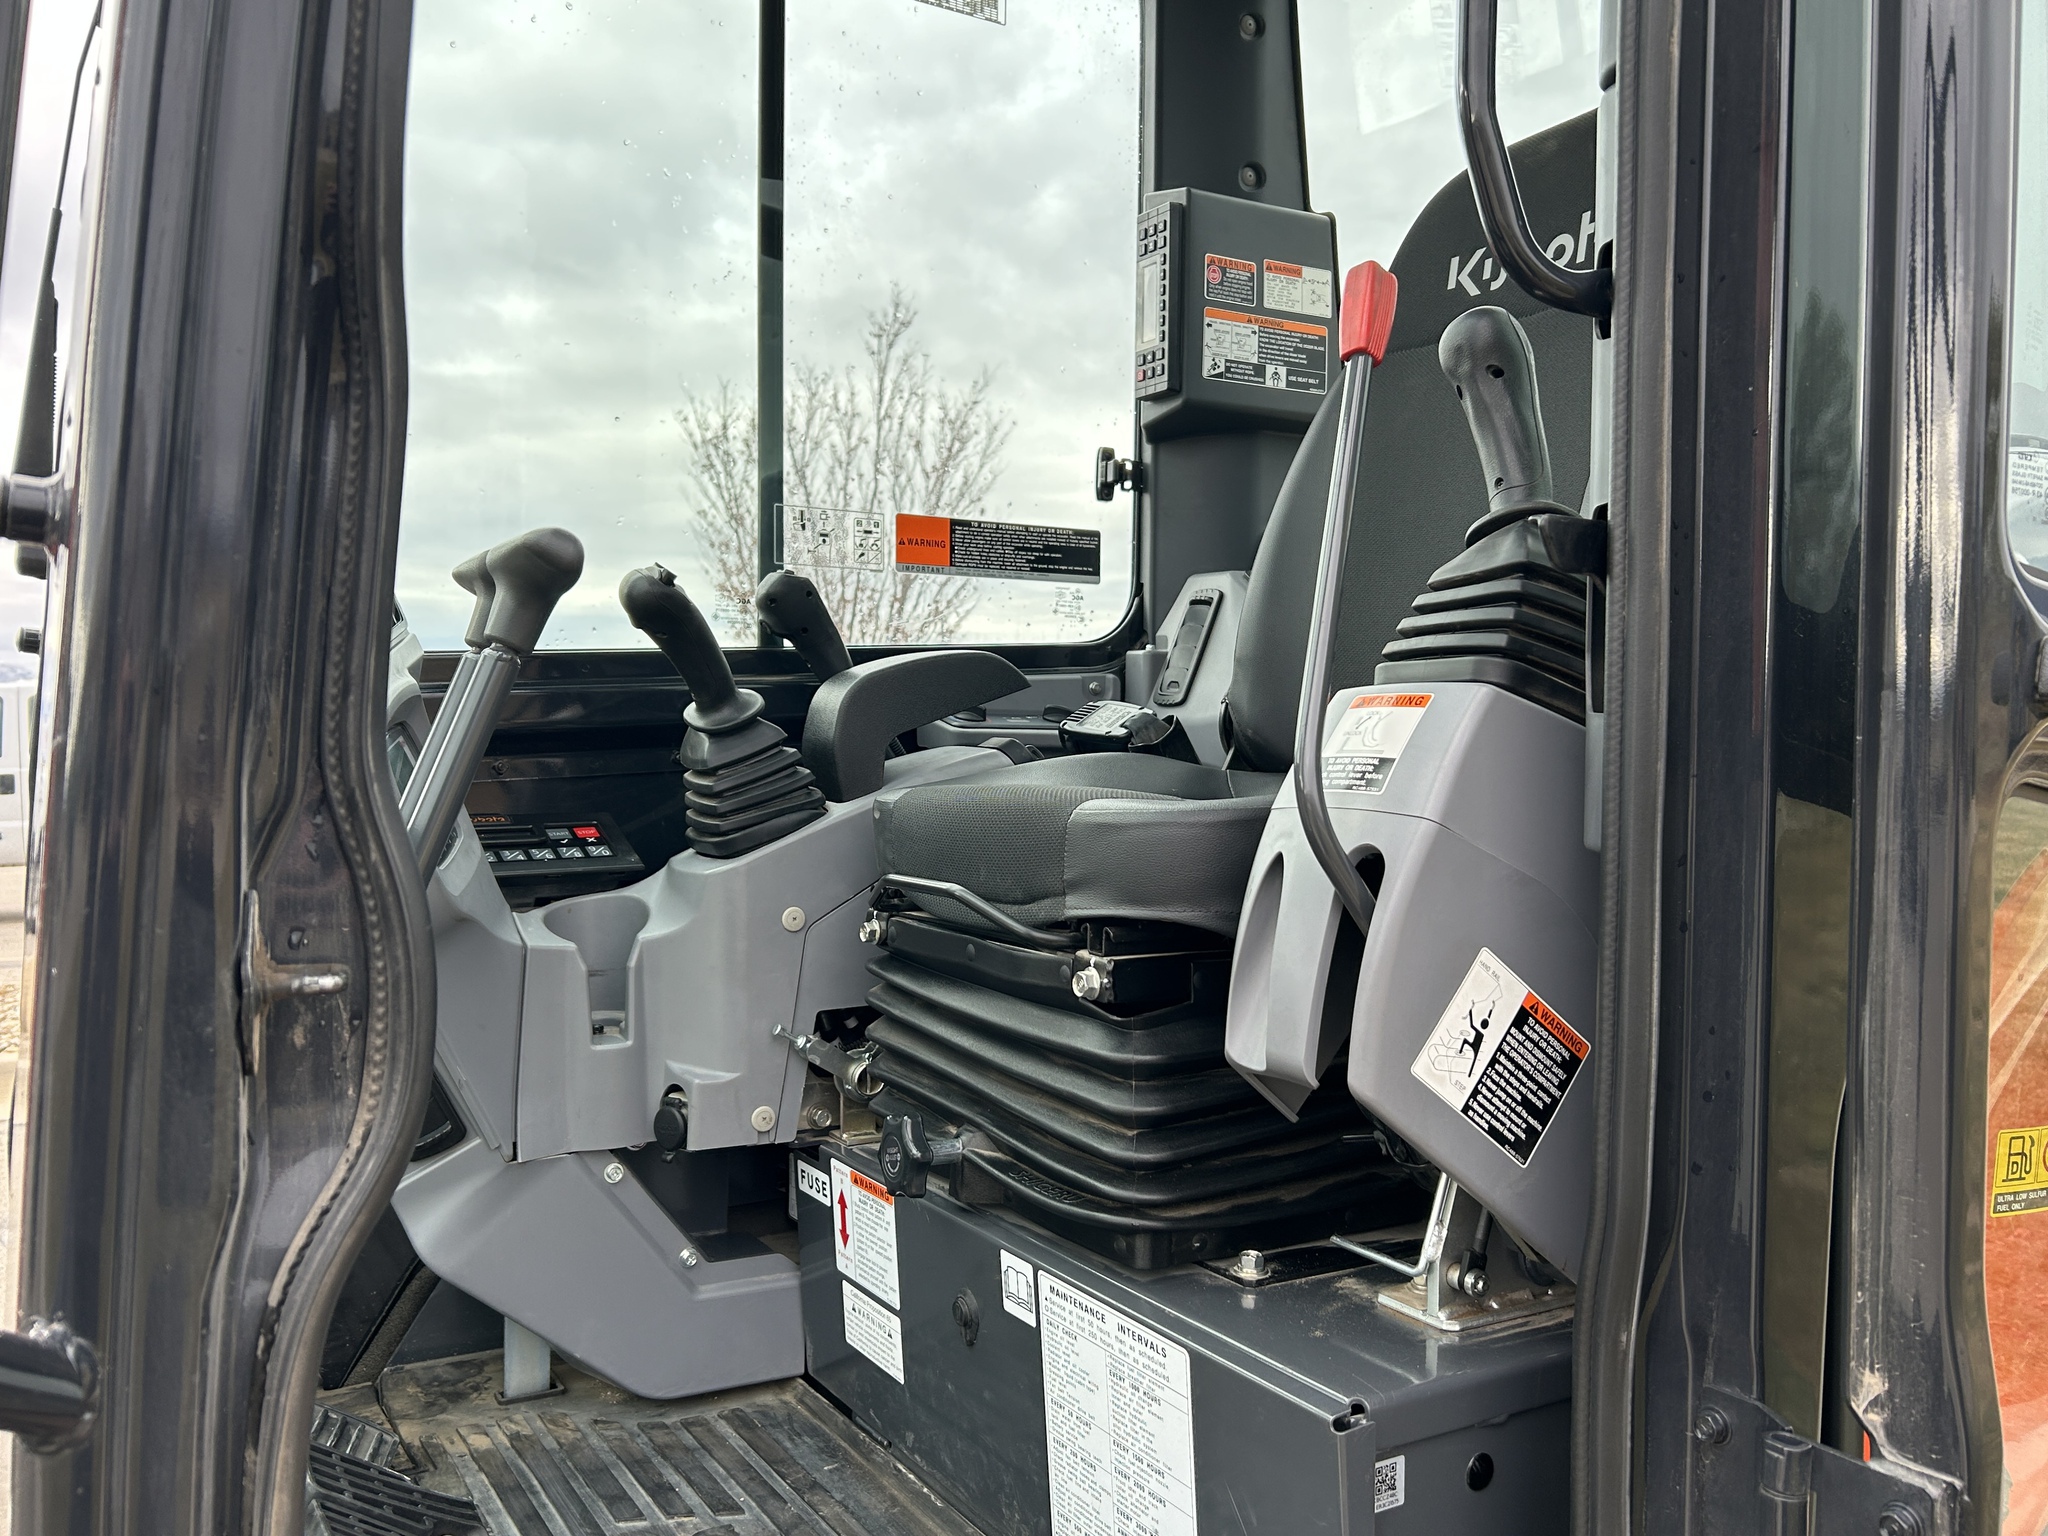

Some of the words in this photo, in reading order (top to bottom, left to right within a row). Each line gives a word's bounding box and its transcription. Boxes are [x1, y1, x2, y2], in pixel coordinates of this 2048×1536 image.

[1217, 258, 1253, 271] WARNING
[1273, 265, 1300, 275] WARNING
[1254, 317, 1284, 328] WARNING
[907, 538, 946, 549] WARNING
[902, 565, 945, 574] IMPORTANT
[1368, 696, 1424, 705] WARNING
[1479, 960, 1491, 972] HAND
[1491, 970, 1501, 982] RAIL
[1521, 1024, 1540, 1043] INJURY
[1537, 1038, 1547, 1049] OR
[1526, 1016, 1535, 1027] TO
[1533, 1022, 1549, 1039] AVOID
[1545, 1034, 1572, 1060] PERSONAL
[1538, 1008, 1584, 1053] WARNING
[1500, 1041, 1511, 1054] THE
[1504, 1033, 1519, 1049] WHEN
[1516, 1044, 1538, 1066] ENTERING
[1535, 1061, 1543, 1071] OR
[1541, 1067, 1559, 1086] LEAVING
[1508, 1026, 1525, 1043] MOUNT
[1522, 1038, 1534, 1051] AND
[1531, 1046, 1553, 1068] DISMOUNT
[1550, 1063, 1567, 1081] SAFELY
[1454, 1079, 1467, 1090] STEP
[801, 1168, 828, 1199] FUSE
[859, 1176, 889, 1201] WARNING
[1996, 1204, 2010, 1212] FUEL
[2011, 1202, 2025, 1210] ONLY
[1997, 1195, 2014, 1203] ULTRA
[2028, 1190, 2047, 1199] SULFUR
[850, 1289, 866, 1305] California
[867, 1301, 886, 1318] Proposition
[858, 1307, 887, 1334] WARNING
[1046, 1318, 1059, 1331] DAILY
[1062, 1327, 1077, 1342] CHECK
[1049, 1284, 1106, 1324] MAINTENANCE
[1117, 1322, 1167, 1358] INTERVALS
[1049, 1297, 1066, 1311] Service
[1076, 1312, 1085, 1323] first
[1088, 1319, 1094, 1328] 50
[1115, 1335, 1127, 1347] then
[1129, 1344, 1135, 1353] as
[1050, 1307, 1067, 1322] Service
[1076, 1322, 1086, 1334] first
[1088, 1330, 1097, 1340] 250
[1118, 1347, 1130, 1360] then
[1133, 1357, 1139, 1365] as
[1109, 1369, 1125, 1384] EVERY
[1143, 1390, 1162, 1406] HOURS
[1050, 1398, 1066, 1413] EVERY
[1075, 1414, 1092, 1431] HOURS
[1052, 1437, 1068, 1452] EVERY
[1080, 1456, 1097, 1472] HOURS
[1113, 1439, 1129, 1454] EVERY
[1146, 1462, 1165, 1479] HOURS
[1114, 1466, 1131, 1482] EVERY
[1148, 1490, 1167, 1507] HOURS
[1057, 1511, 1072, 1526] EVERY
[1116, 1507, 1133, 1524] EVERY
